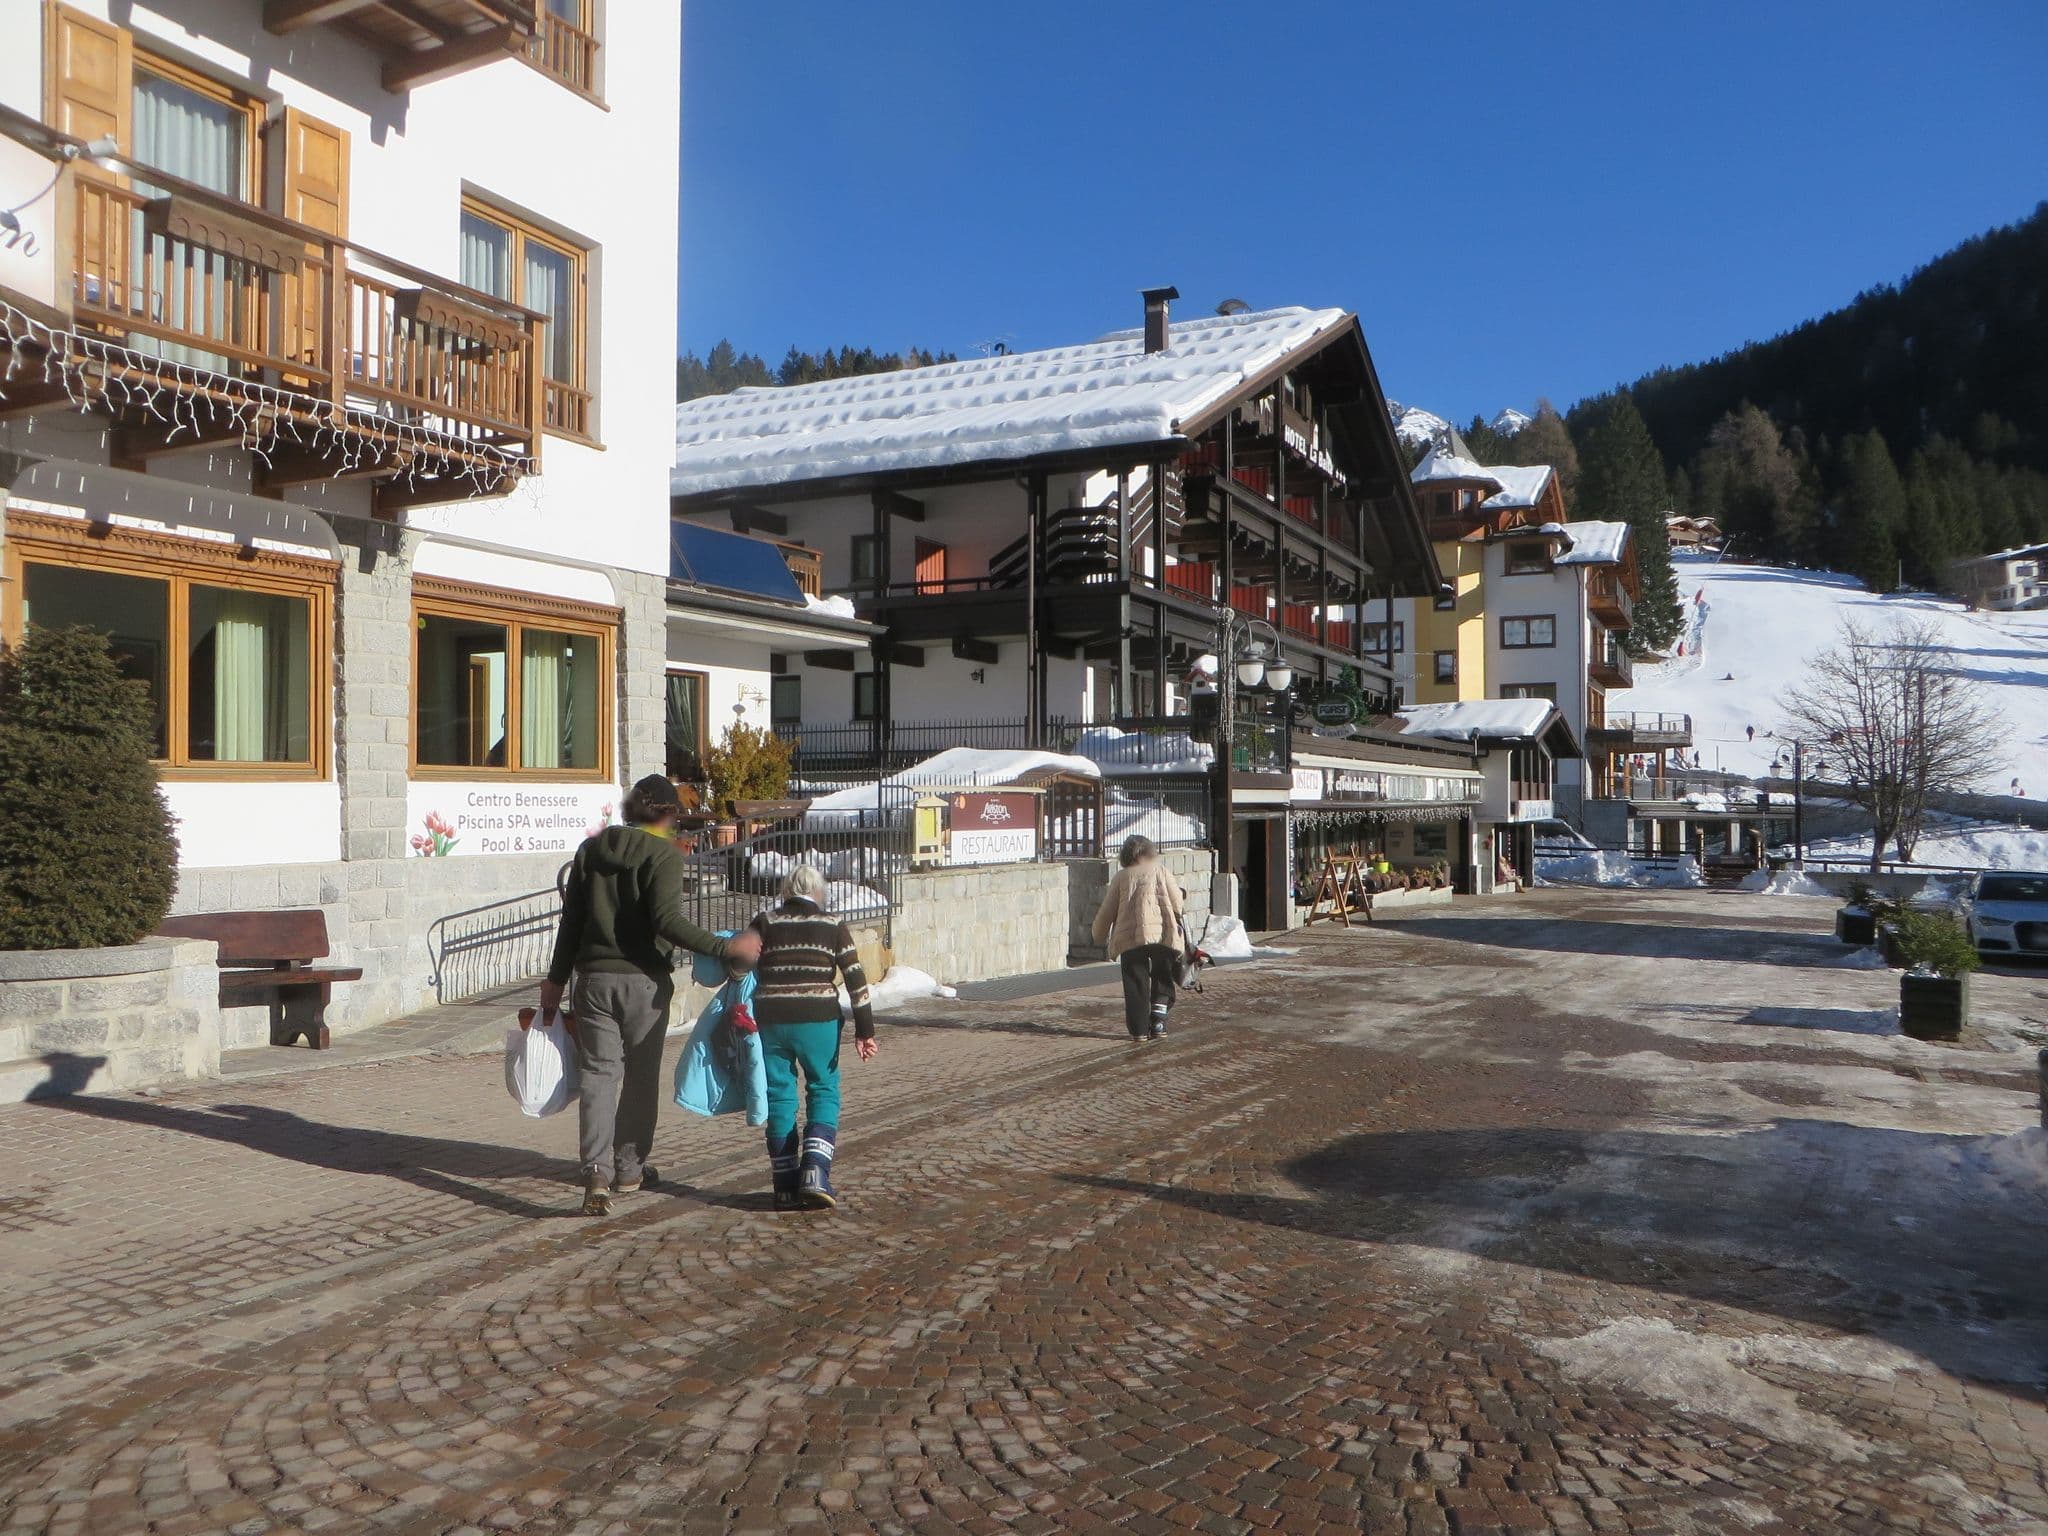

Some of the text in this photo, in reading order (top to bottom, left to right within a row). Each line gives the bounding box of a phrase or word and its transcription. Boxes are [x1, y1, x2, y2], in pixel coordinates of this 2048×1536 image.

[467, 792, 578, 807] Centro Benessere
[458, 814, 587, 829] Piscina SPA wellness
[481, 837, 566, 852] Pool & Sauna
[961, 834, 1030, 855] RESTAURANT
